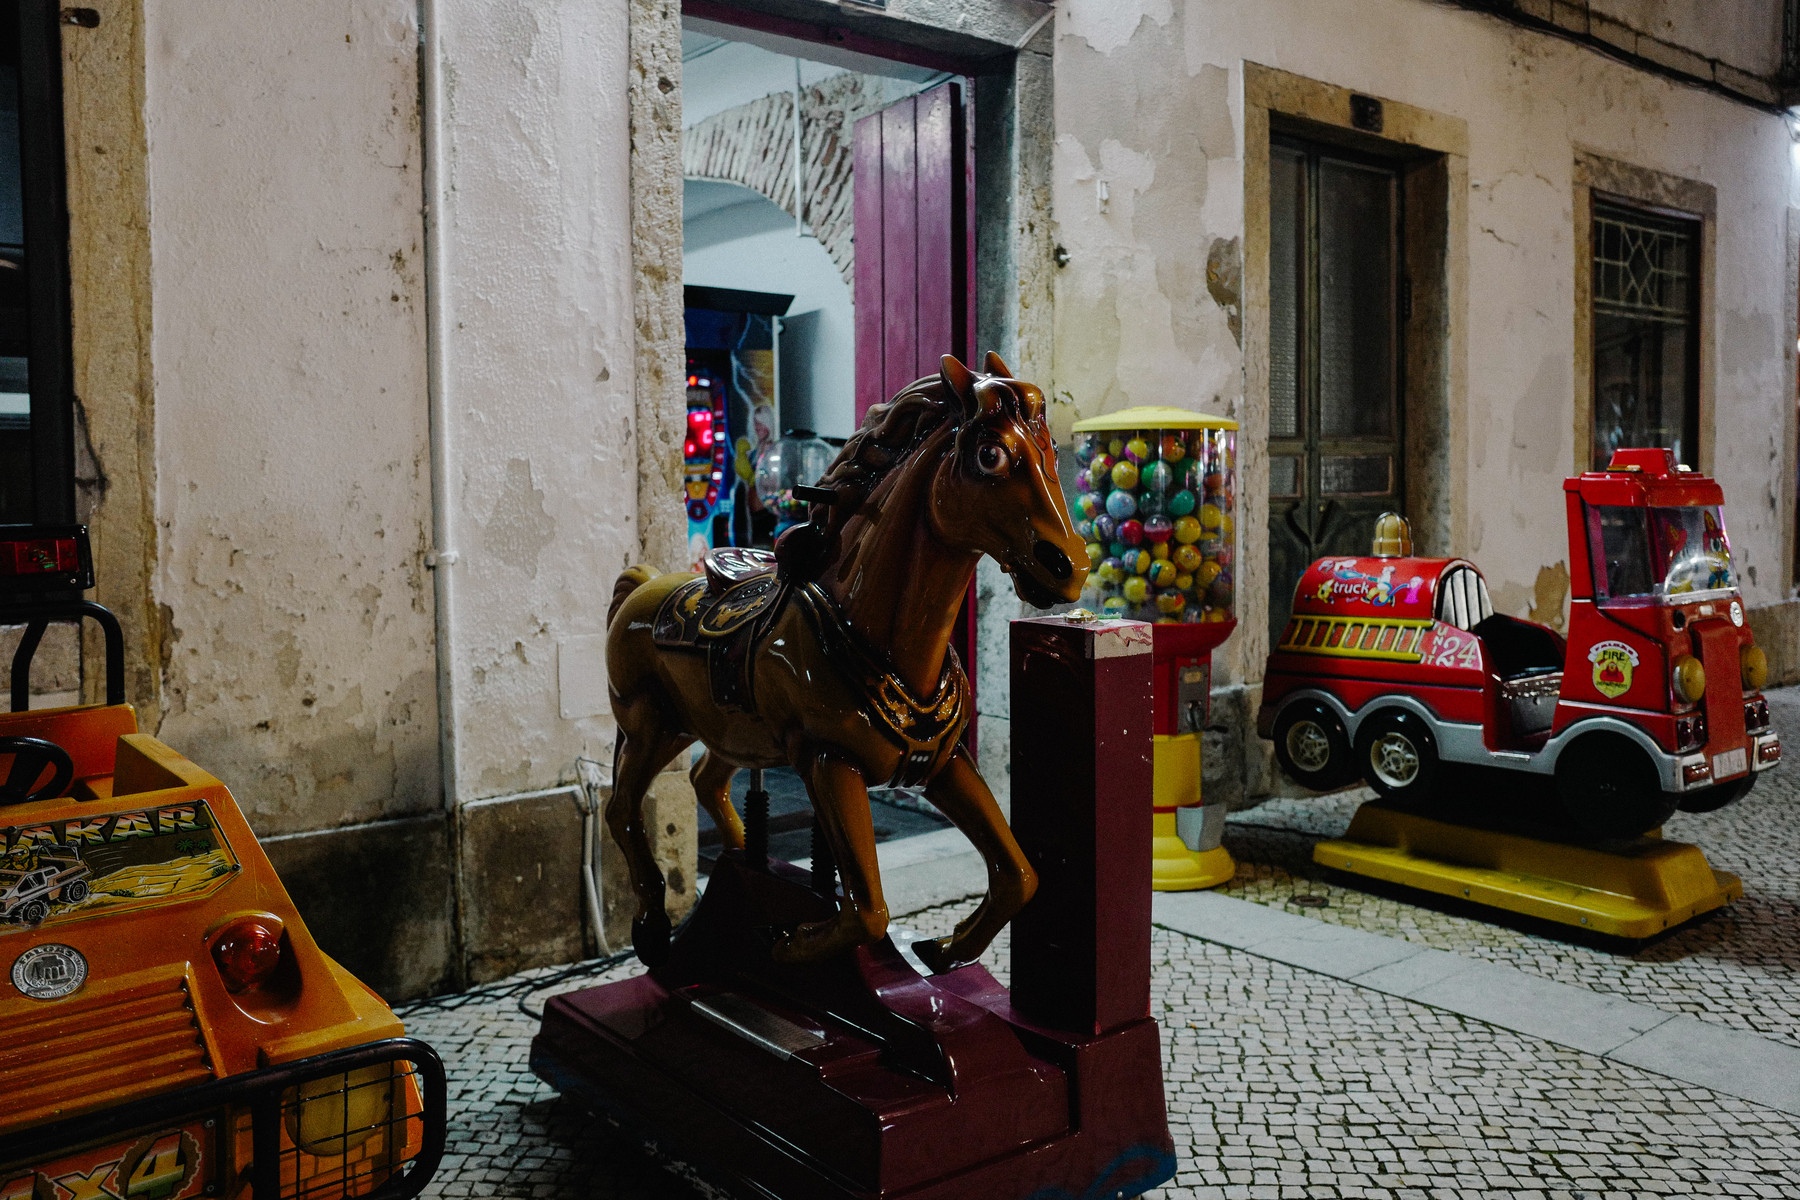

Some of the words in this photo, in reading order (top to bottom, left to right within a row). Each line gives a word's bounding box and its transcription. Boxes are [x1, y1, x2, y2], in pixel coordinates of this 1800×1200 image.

[1333, 581, 1370, 595] truck
[1427, 625, 1449, 665] UNIT
[1435, 636, 1477, 668] 24
[1602, 650, 1625, 661] FIRE
[0, 806, 210, 858] AKAR
[19, 946, 76, 965] FALGAS
